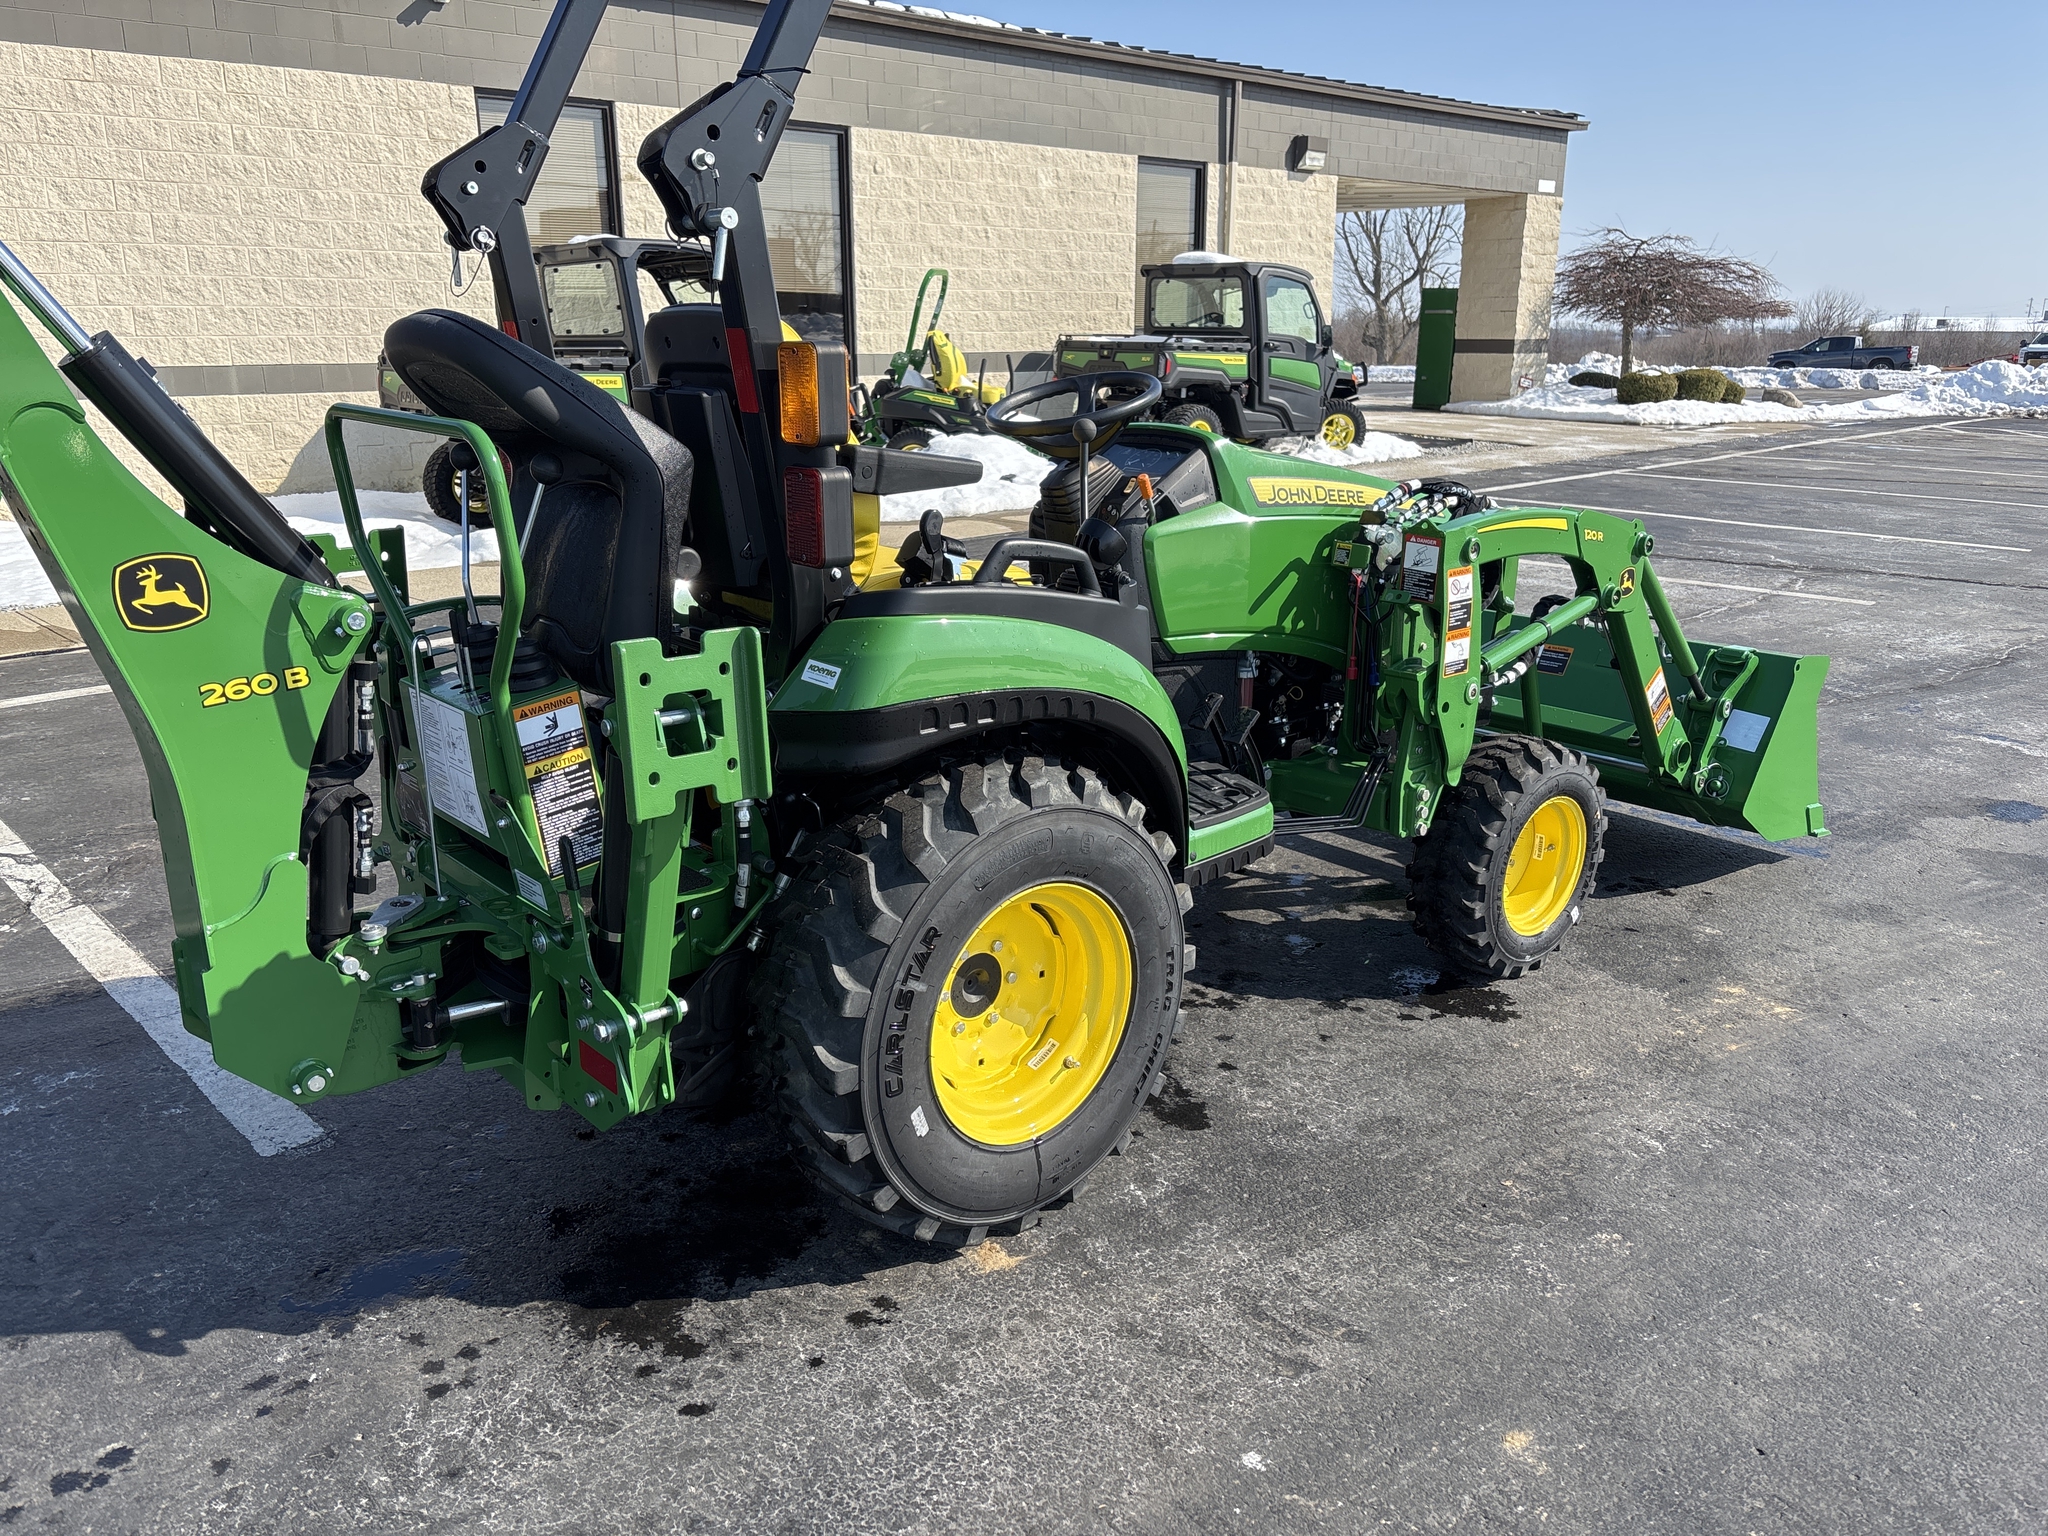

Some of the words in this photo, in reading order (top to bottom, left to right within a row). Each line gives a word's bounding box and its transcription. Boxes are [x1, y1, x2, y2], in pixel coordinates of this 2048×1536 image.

[1268, 484, 1312, 502] JOHN
[1315, 485, 1366, 504] DEERE
[1417, 538, 1437, 546] DANGER
[1452, 567, 1472, 577] WARNING
[1451, 631, 1470, 640] WARNING
[199, 672, 280, 708] 260
[282, 666, 311, 691] B
[528, 696, 574, 715] WARNING
[542, 753, 584, 772] CAUTION
[1163, 946, 1175, 1012] TRAC
[885, 926, 943, 1098] CARLSTAR
